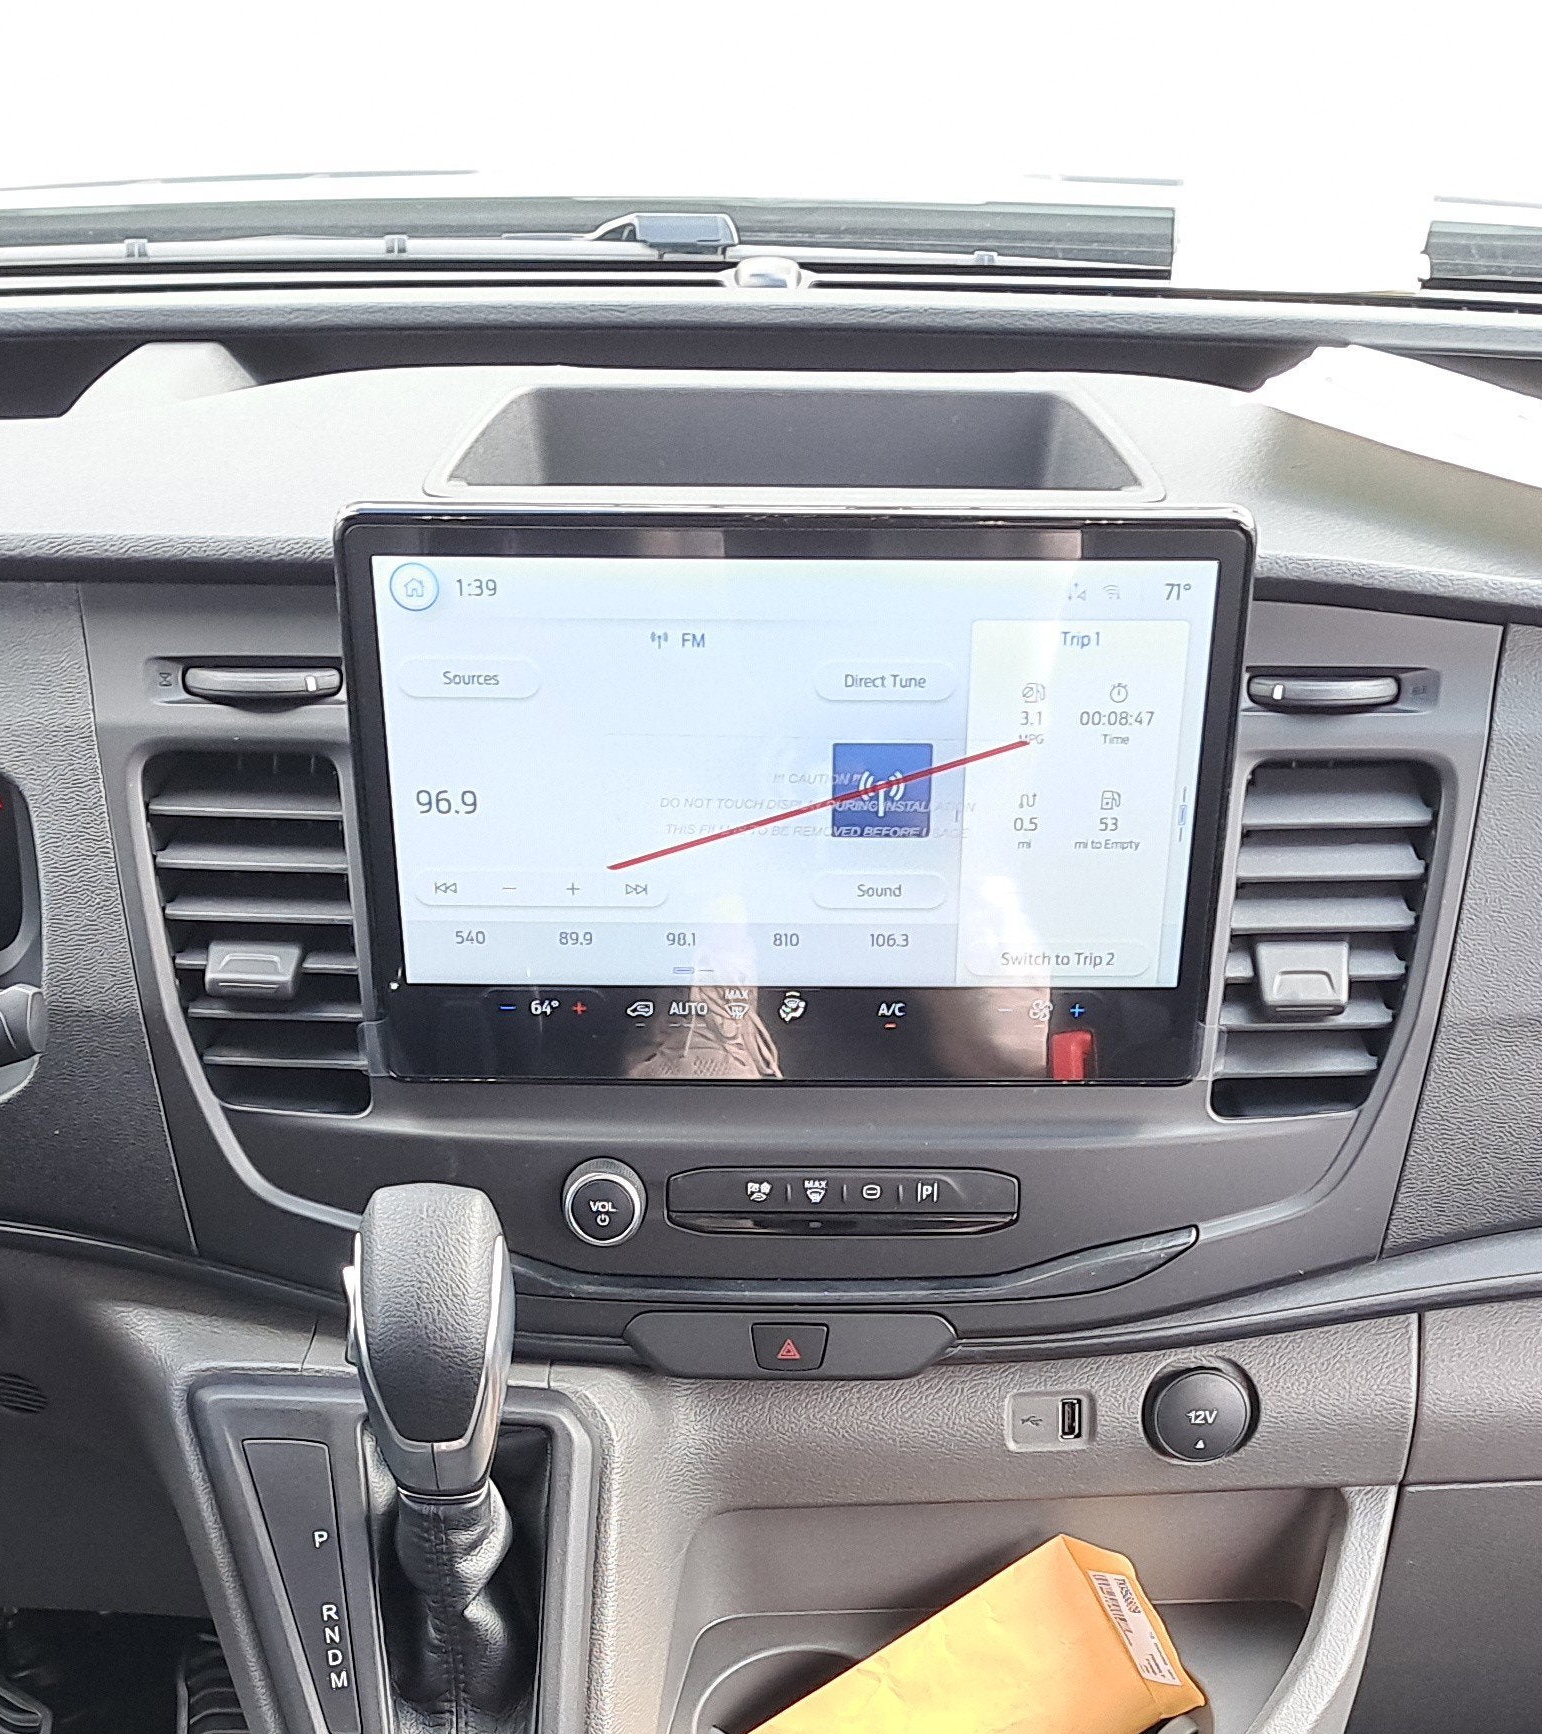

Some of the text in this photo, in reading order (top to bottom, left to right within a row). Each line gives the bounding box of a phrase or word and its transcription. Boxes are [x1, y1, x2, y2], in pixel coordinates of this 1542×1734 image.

[455, 578, 498, 597] 1:39
[680, 633, 706, 648] FM
[1061, 631, 1101, 649] Trip 1
[442, 671, 500, 686] Sources
[844, 674, 927, 689] Direct Tune
[1019, 711, 1043, 726] 3.1
[1079, 711, 1155, 726] 00:08:47
[1102, 733, 1130, 745] Time
[415, 789, 478, 815] 96.9
[659, 797, 681, 808] DO
[683, 797, 712, 809] NOT
[717, 798, 764, 810] TOUCH
[665, 824, 696, 835] THIS
[862, 826, 921, 838] BEFORE
[1013, 817, 1038, 832] 0.5
[1098, 817, 1119, 832] 53
[1017, 839, 1032, 850] mi
[1090, 839, 1102, 850] to
[1104, 839, 1141, 852] Empty
[856, 883, 902, 898] Sound
[454, 931, 486, 945] 540
[558, 931, 593, 946] 89.9
[666, 932, 697, 947] 98.1
[772, 933, 800, 947] 810
[869, 933, 910, 947] 106.3
[1000, 952, 1115, 969] Switch to Trip 2
[724, 989, 749, 1000] MAX
[530, 1000, 560, 1016] 64°
[669, 1001, 708, 1016] AUTO
[877, 1002, 906, 1017] A/C
[804, 1179, 828, 1189] MAX
[589, 1200, 617, 1213] VOL
[1186, 1409, 1218, 1425] 12V
[313, 1531, 328, 1548] P
[322, 1604, 339, 1622] R
[324, 1626, 340, 1644] N
[327, 1649, 343, 1666] D
[330, 1670, 348, 1689] M
